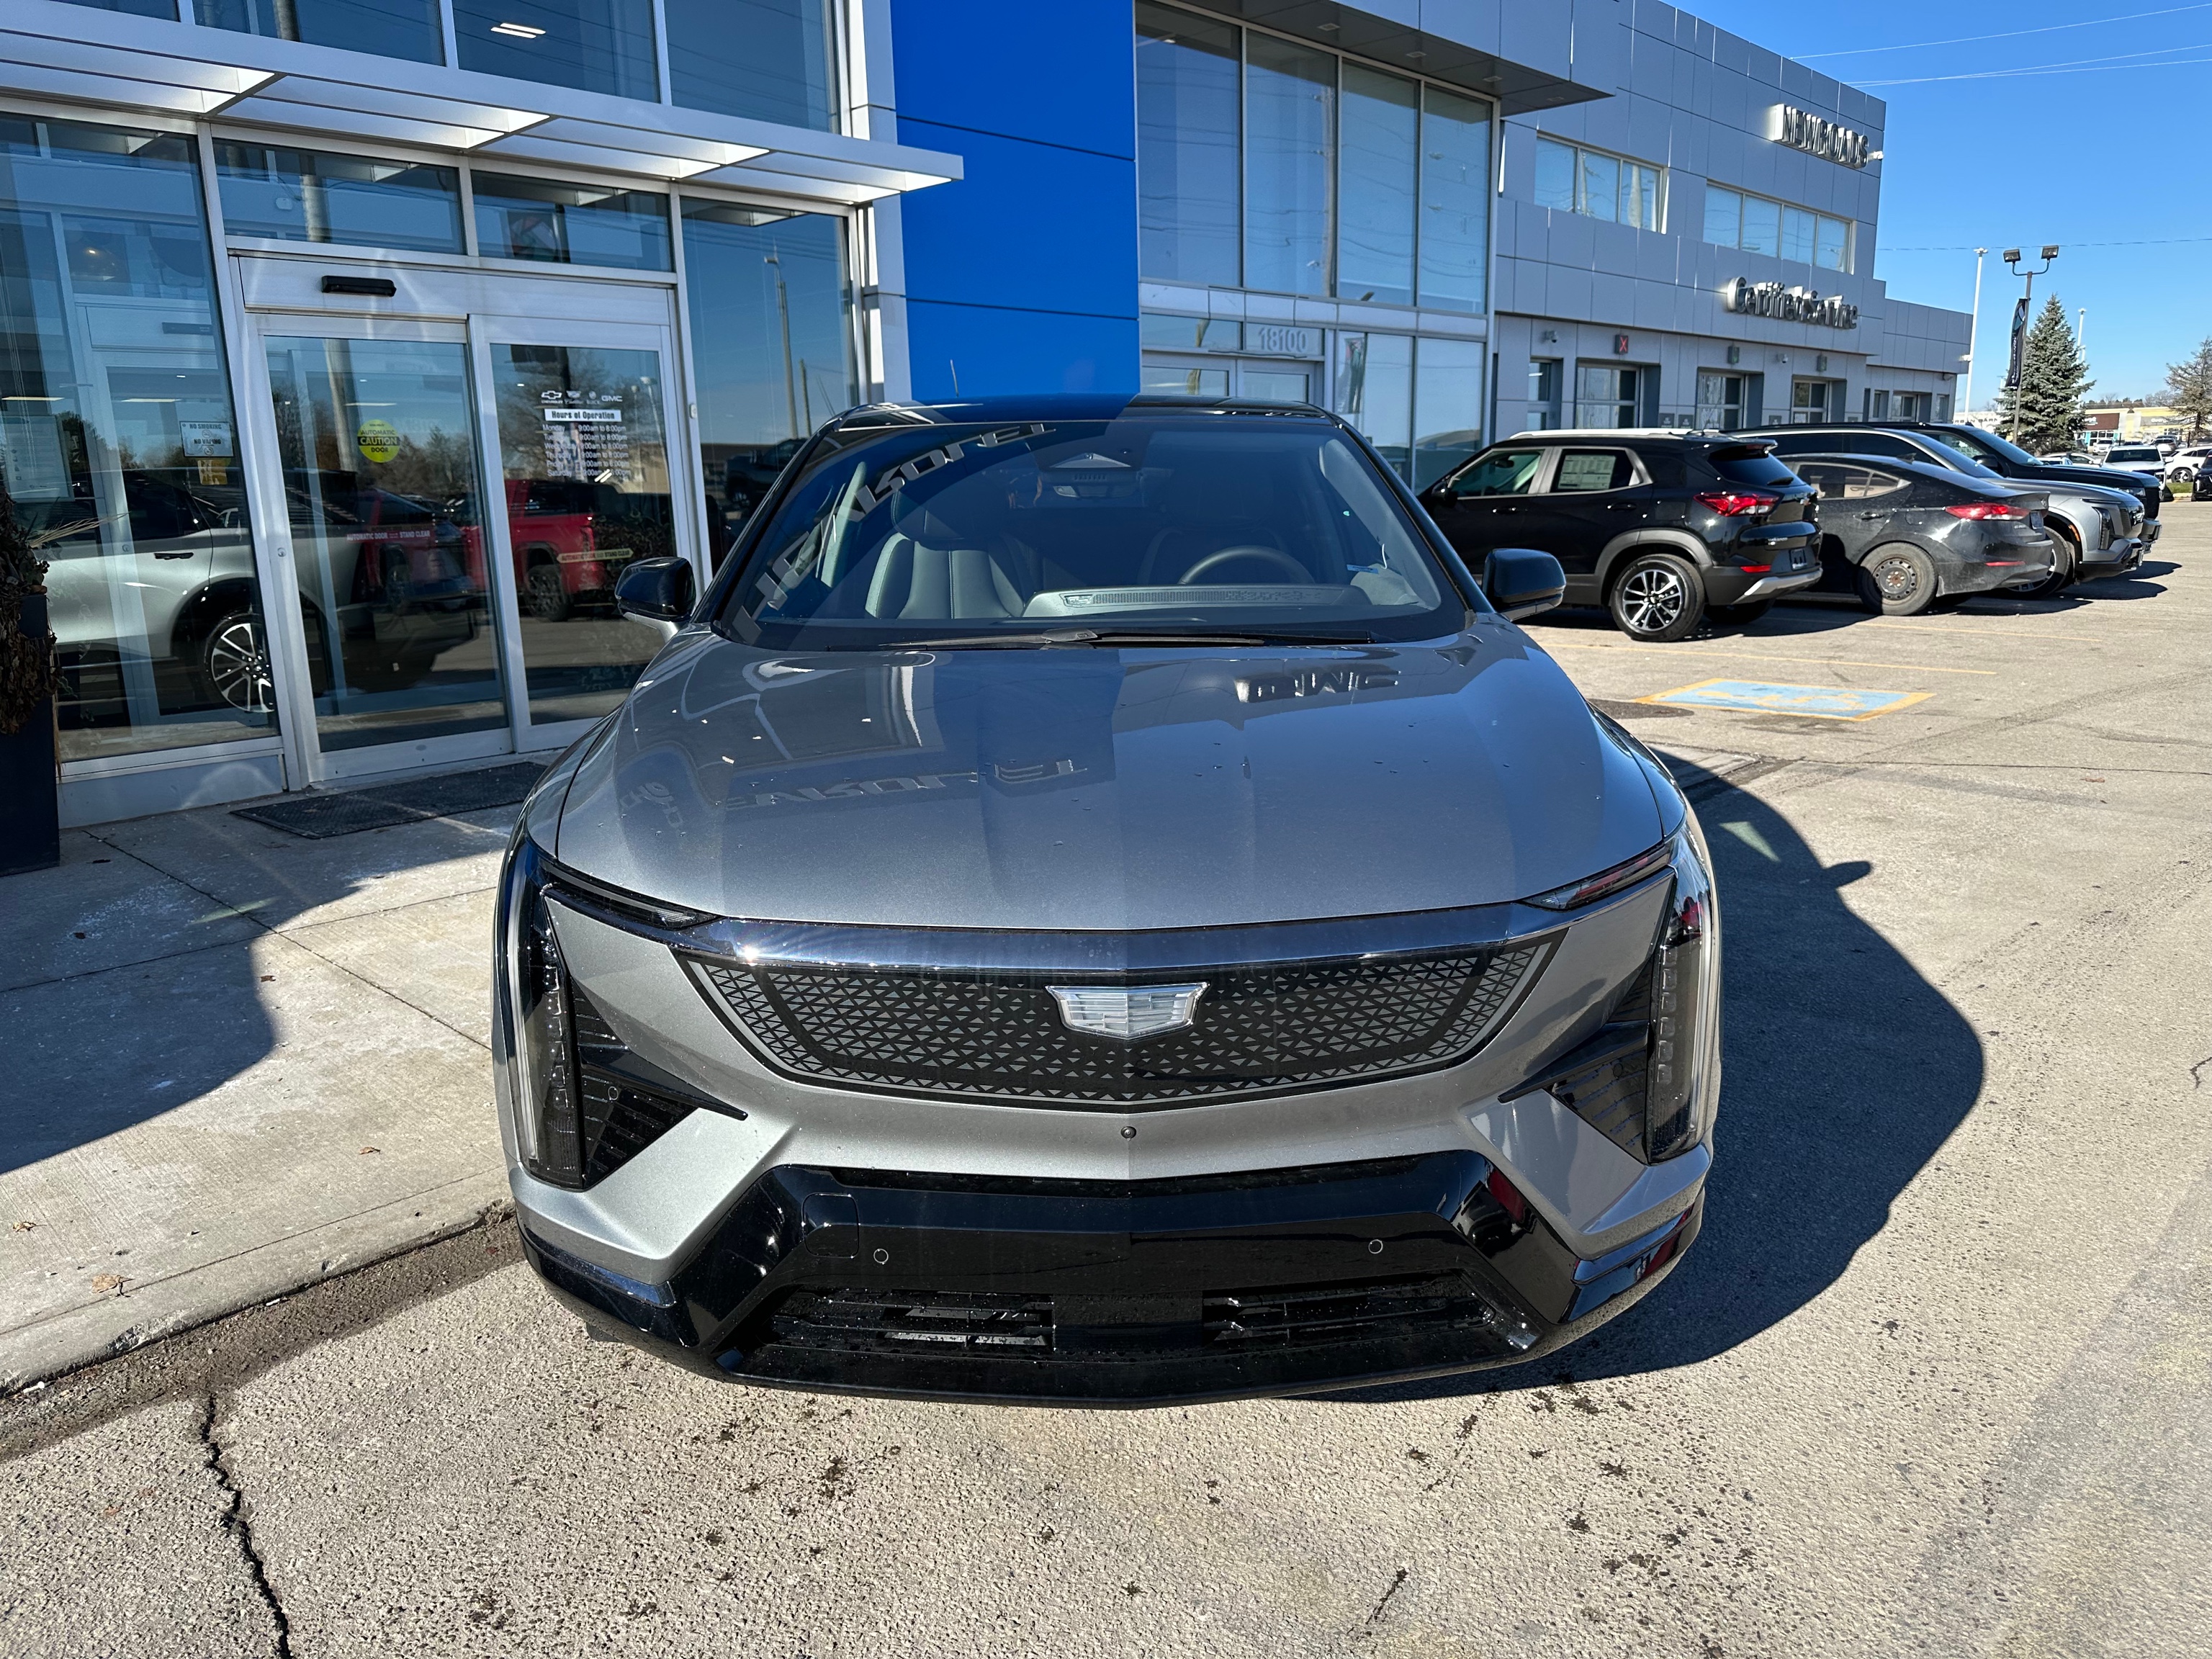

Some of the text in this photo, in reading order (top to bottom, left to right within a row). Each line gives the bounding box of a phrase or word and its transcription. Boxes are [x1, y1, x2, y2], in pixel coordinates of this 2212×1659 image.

[1772, 104, 1869, 168] NEWROADS
[1260, 327, 1308, 353] 18100
[583, 411, 615, 421] Operation
